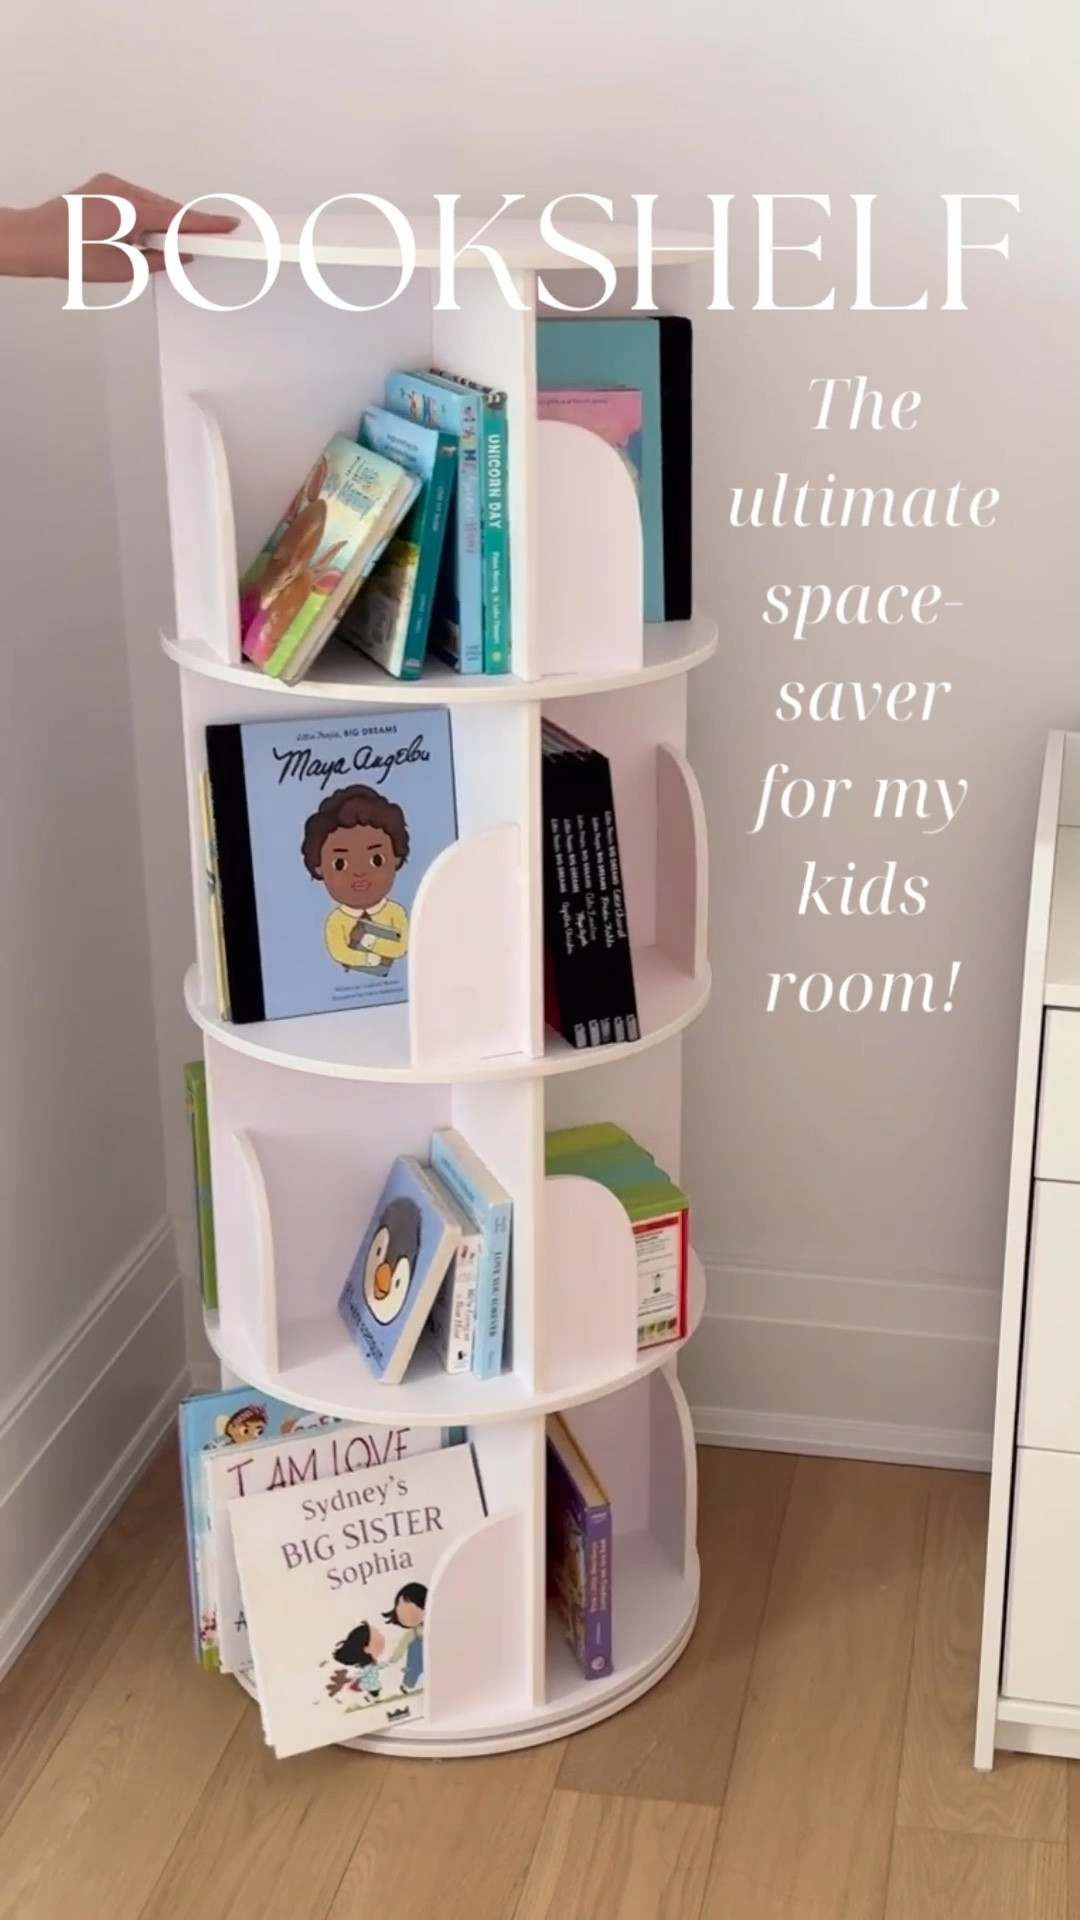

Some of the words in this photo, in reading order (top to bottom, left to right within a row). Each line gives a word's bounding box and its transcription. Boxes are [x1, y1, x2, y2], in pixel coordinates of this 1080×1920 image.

[488, 434, 502, 497] UNICORN
[489, 502, 503, 529] DAY
[343, 728, 359, 737] BIG
[362, 725, 397, 735] DREAMS
[272, 747, 351, 790] Maya
[353, 734, 430, 785] Angelou
[265, 1449, 318, 1490] AM
[333, 1427, 411, 1477] LOVE
[301, 1475, 409, 1522] Sydney's
[281, 1533, 336, 1570] BIG
[342, 1506, 444, 1550] SISTER
[326, 1549, 414, 1590] Sophia
